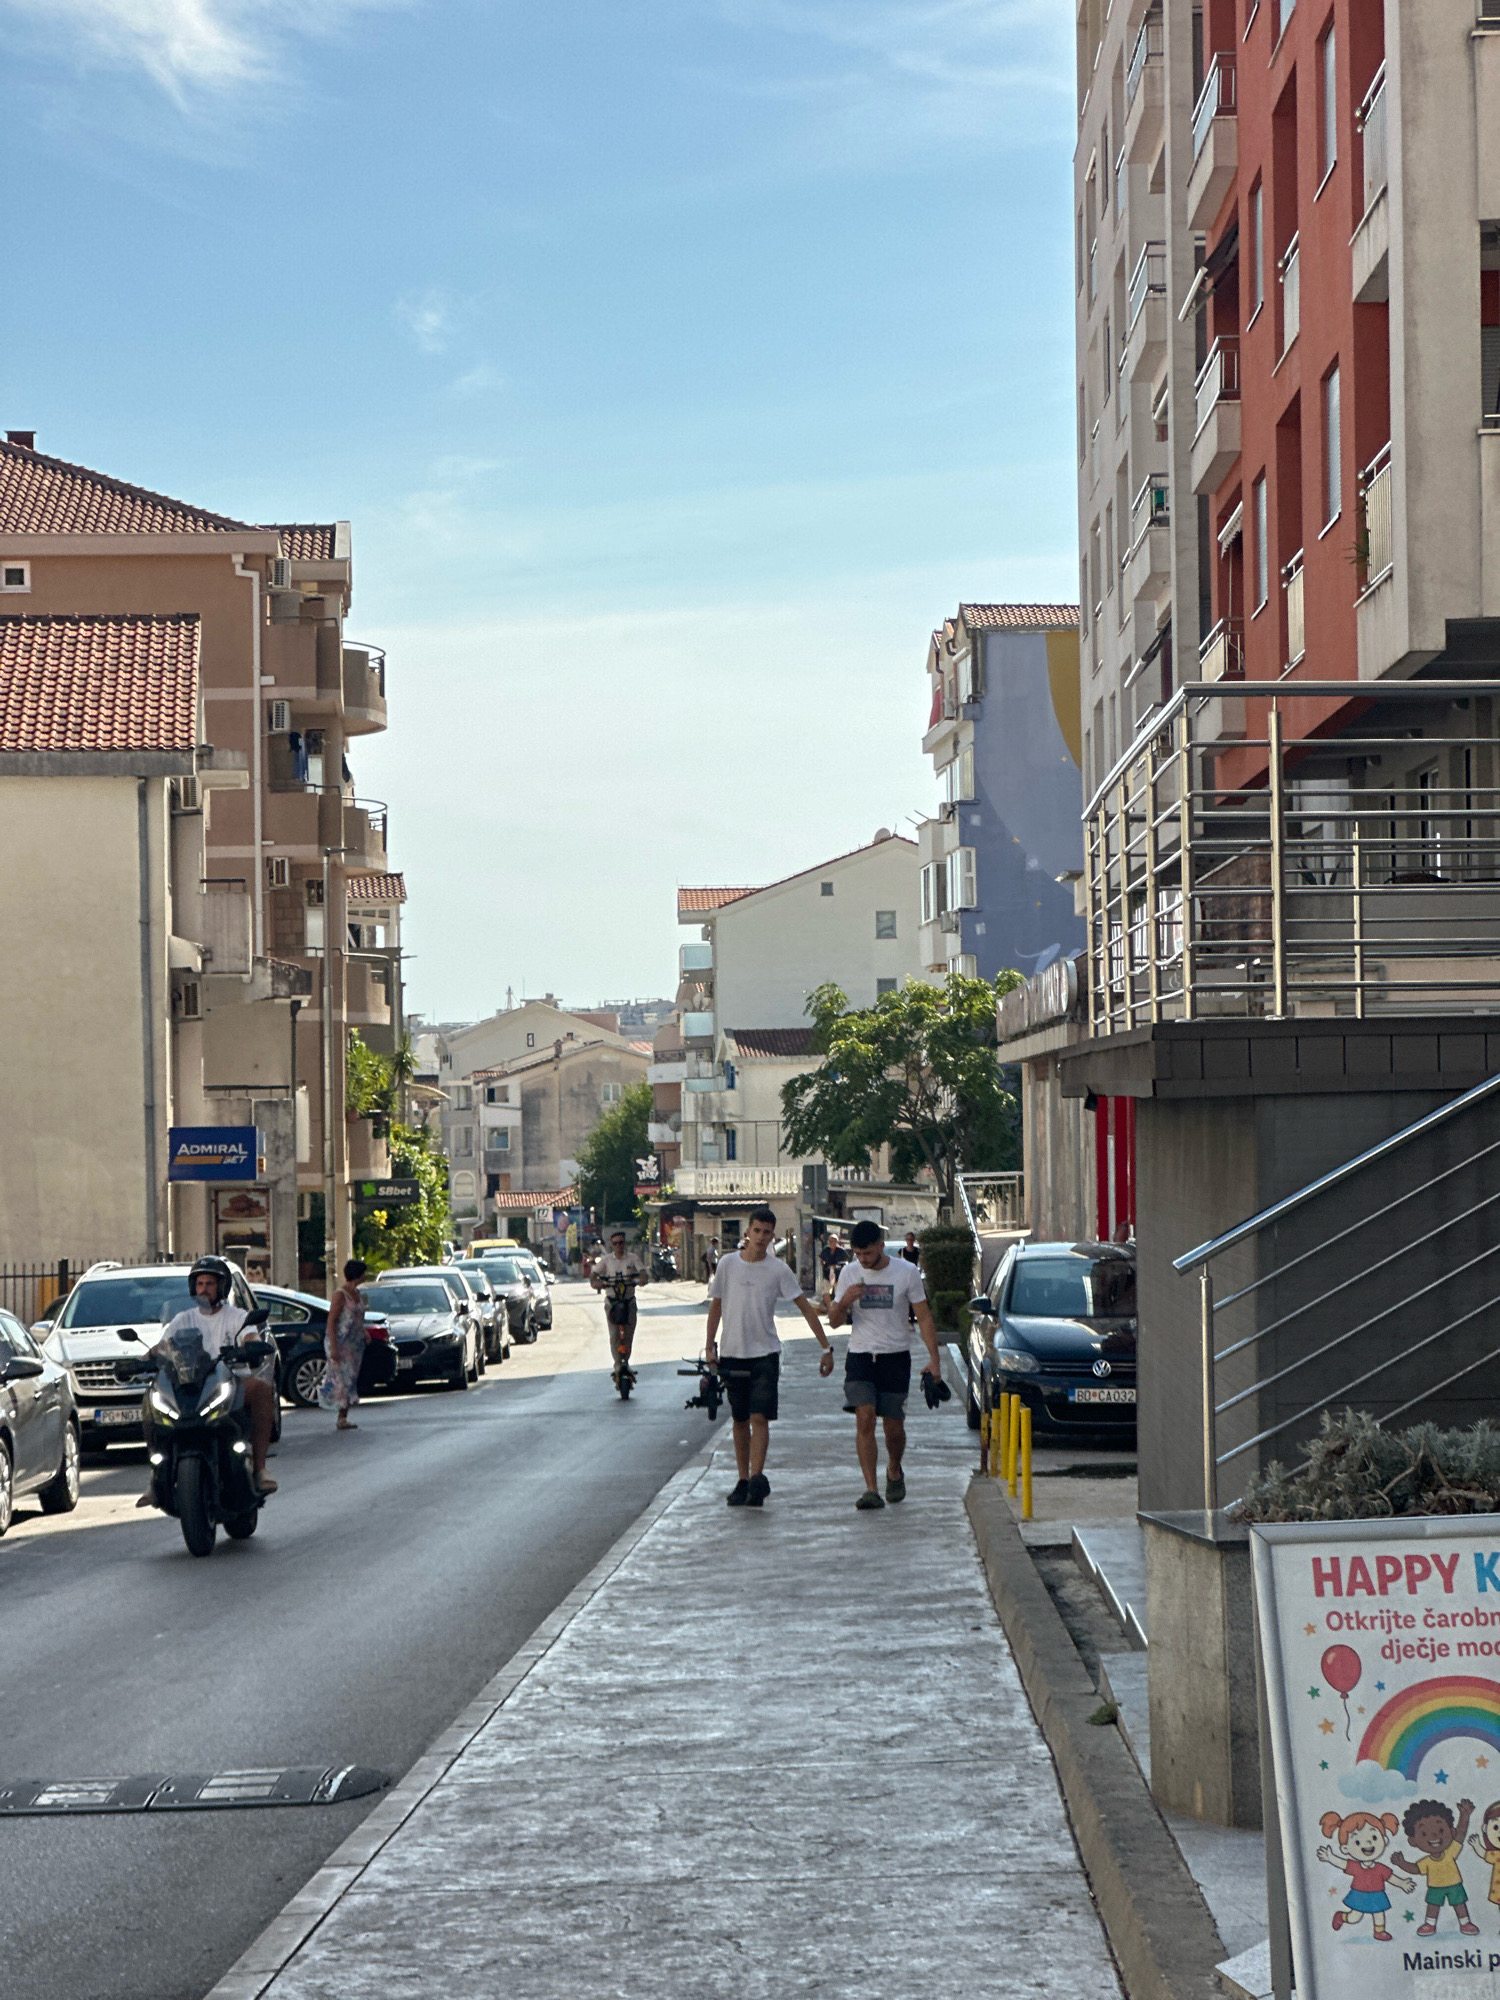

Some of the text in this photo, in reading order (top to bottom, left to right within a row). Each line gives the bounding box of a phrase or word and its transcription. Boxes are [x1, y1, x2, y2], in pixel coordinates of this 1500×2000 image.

[177, 1143, 248, 1155] ADMIRAL
[1311, 1553, 1460, 1598] HAPPY
[1325, 1609, 1417, 1635] Otkrijte
[1380, 1637, 1450, 1664] dječje
[1403, 1948, 1482, 1971] Mainski
